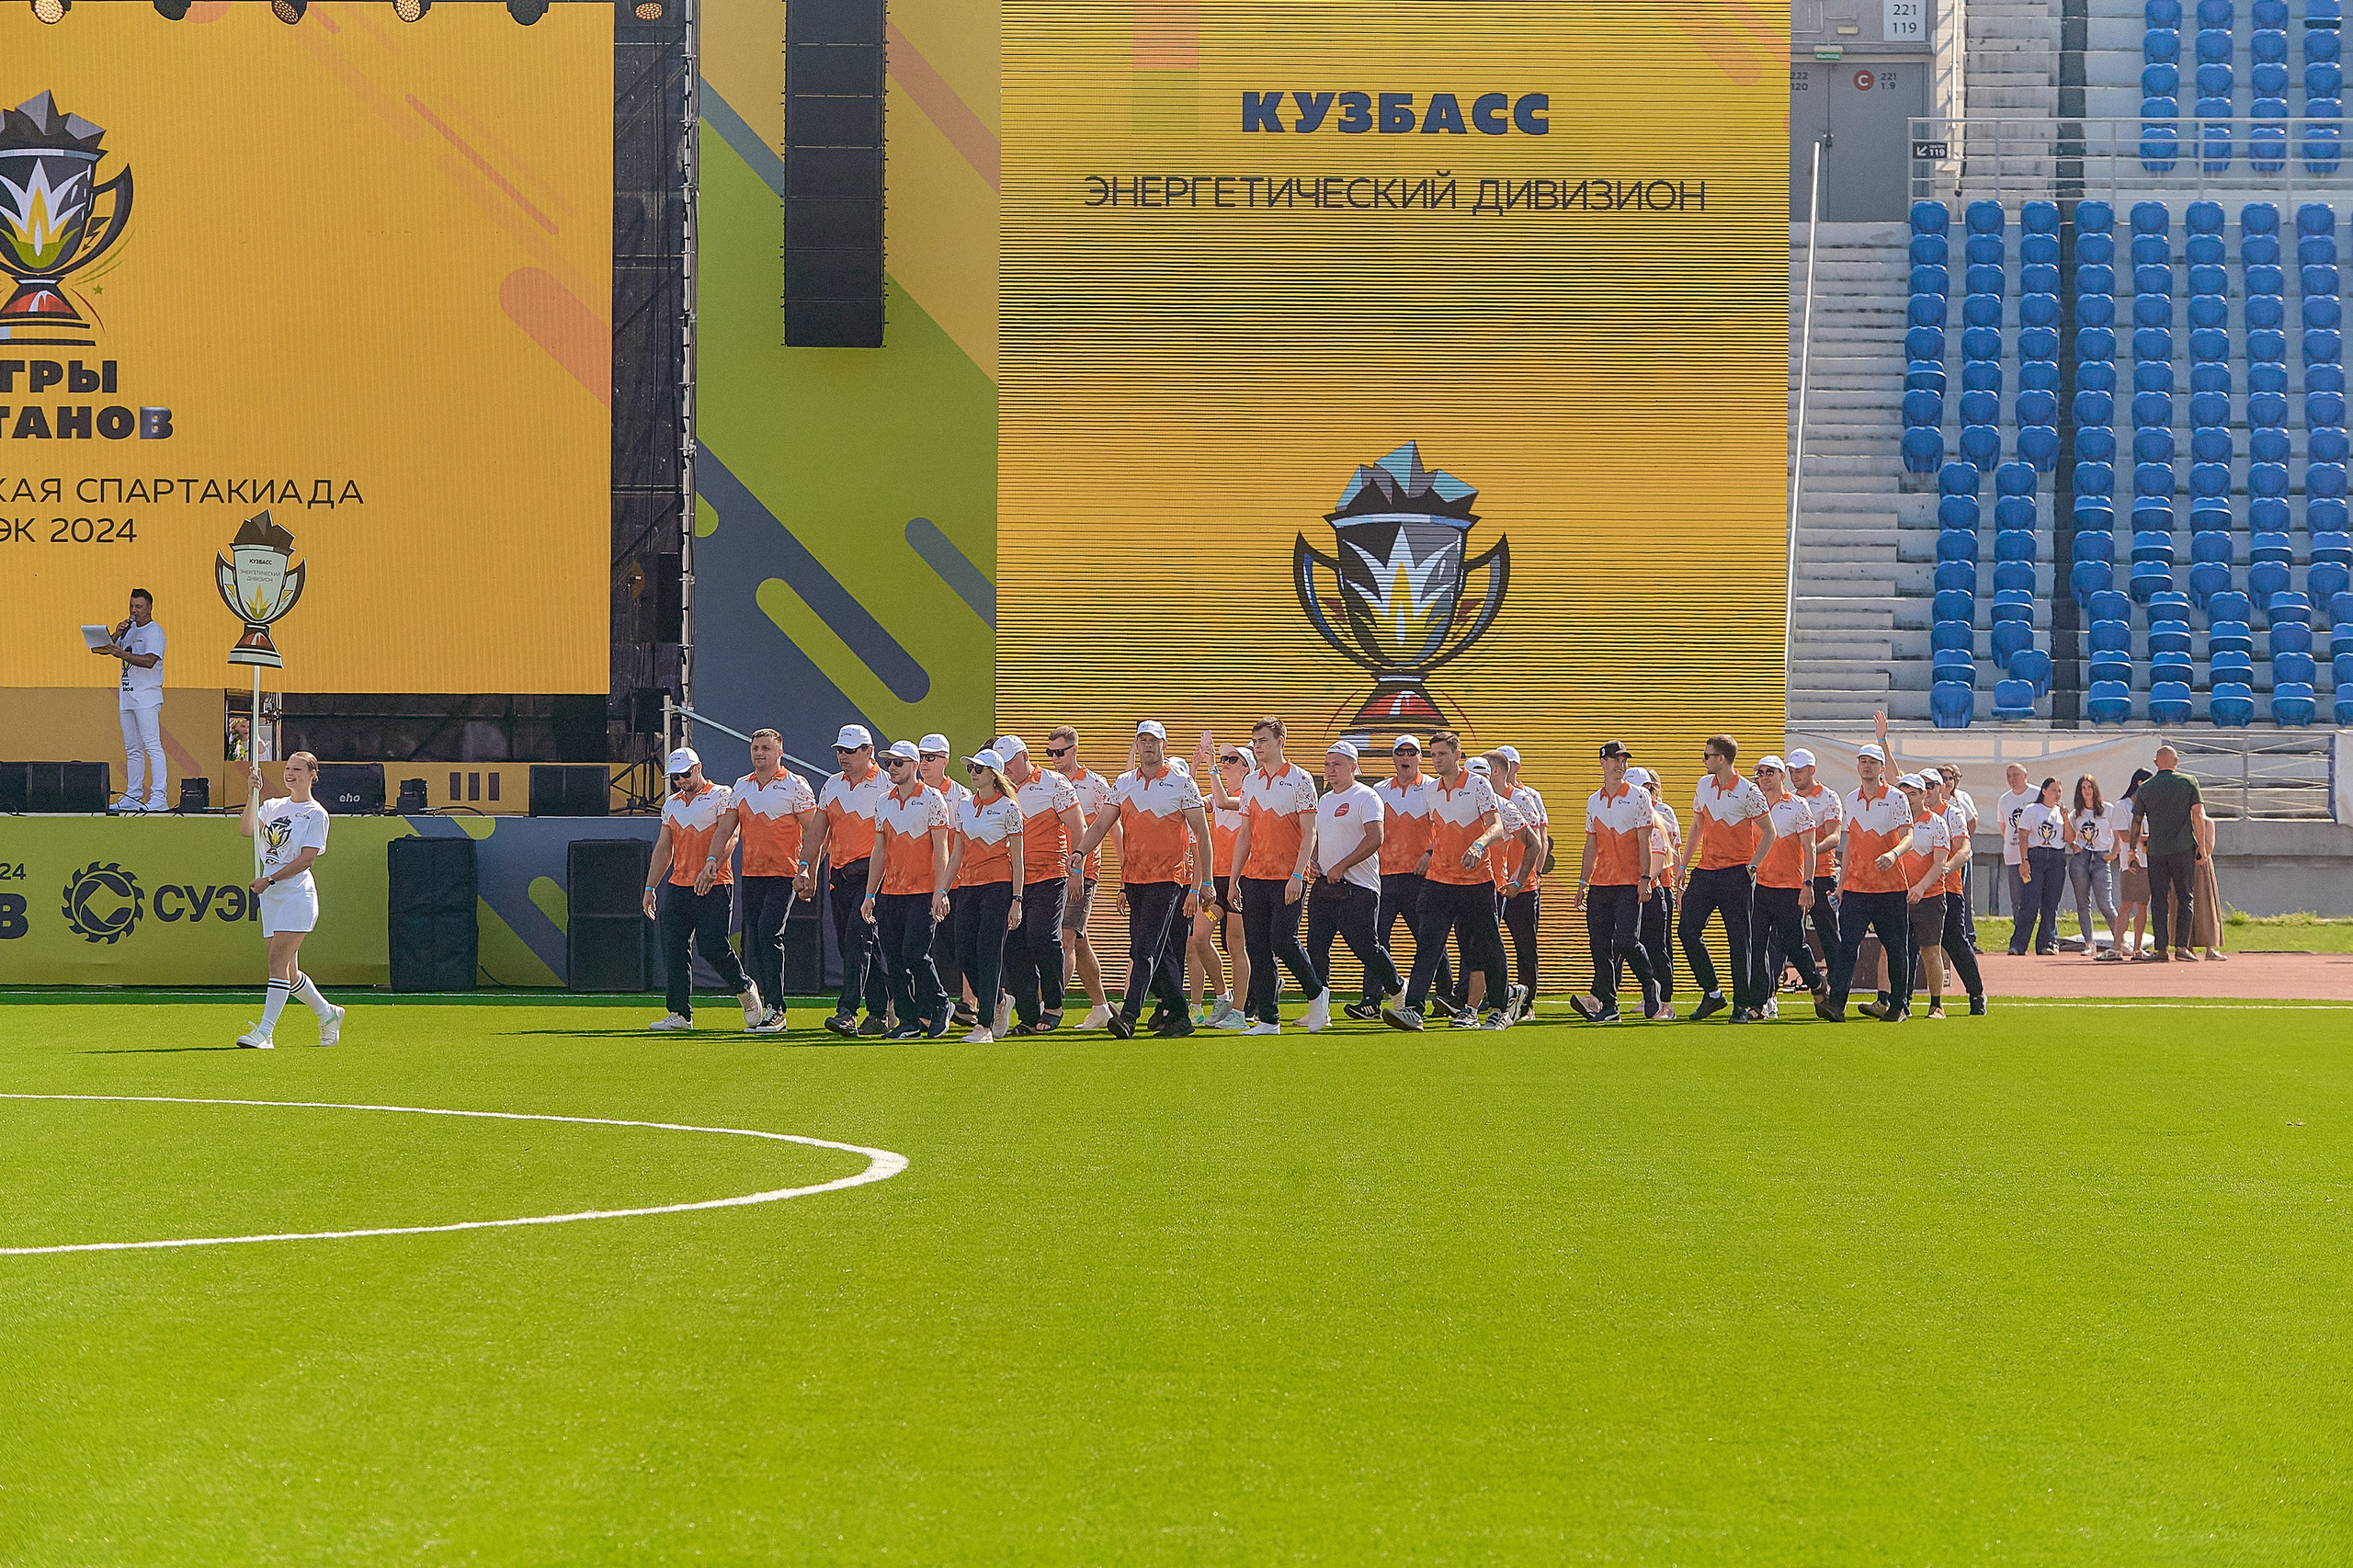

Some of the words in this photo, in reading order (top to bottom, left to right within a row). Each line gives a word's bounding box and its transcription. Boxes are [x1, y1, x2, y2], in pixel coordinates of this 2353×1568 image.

[1893, 4, 1917, 16] 221
[1893, 22, 1917, 34] 119
[1881, 73, 1897, 81] 221
[1881, 82, 1896, 90] 19
[1242, 92, 1550, 135] КУЗБАСС
[1930, 148, 1946, 157] 119
[1085, 169, 1456, 210] ЭНЕРГЕТИЧЕСКИЙ
[1472, 179, 1705, 216] ДИВИЗИОН
[75, 478, 365, 509] СПАРТАКИАДА
[50, 517, 138, 543] 2024
[339, 792, 361, 802] eho
